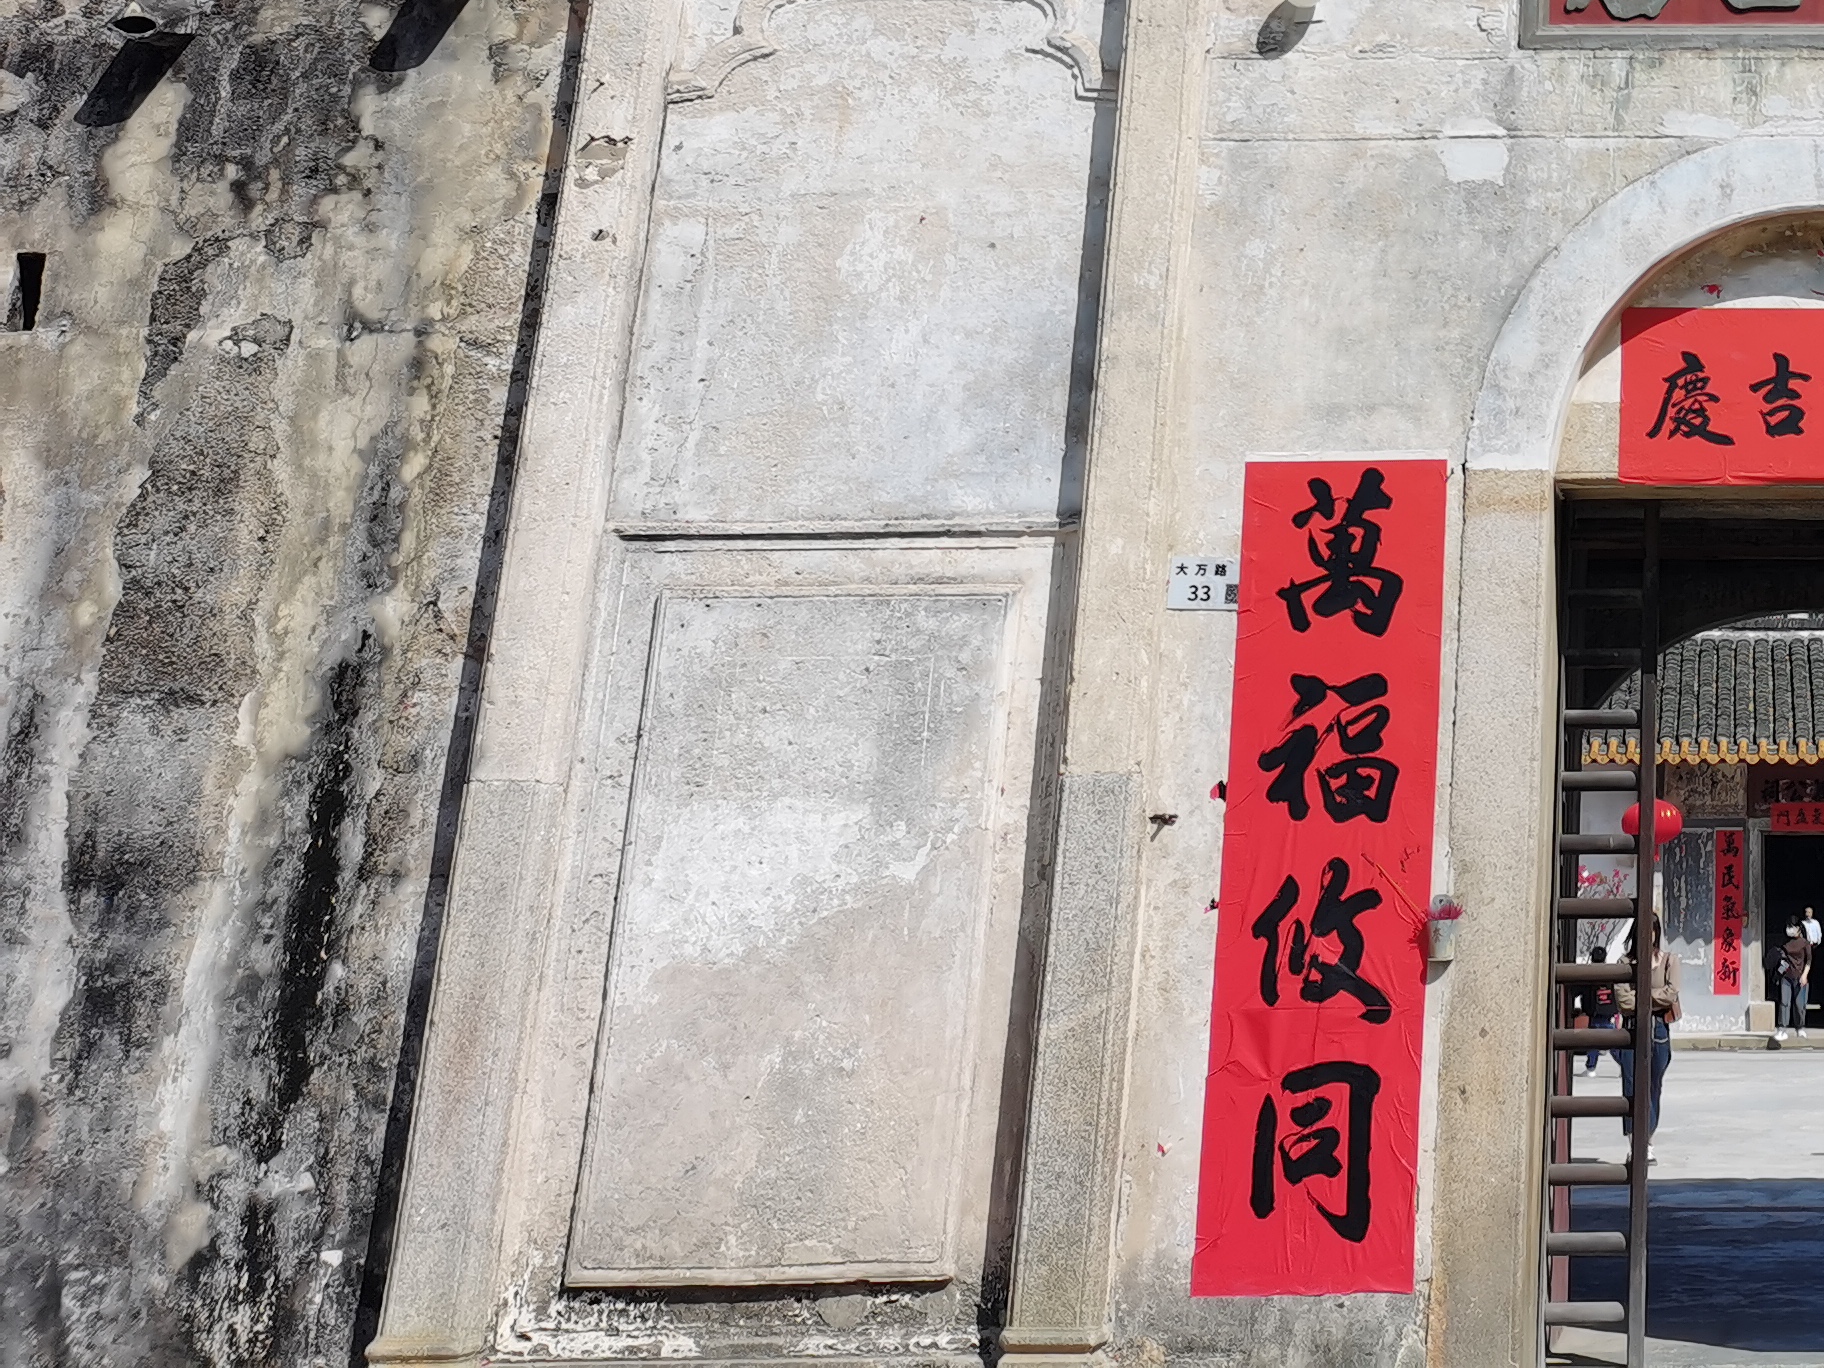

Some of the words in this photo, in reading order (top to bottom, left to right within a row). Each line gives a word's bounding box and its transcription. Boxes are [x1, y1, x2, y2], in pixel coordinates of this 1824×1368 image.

[1175, 562, 1227, 577] 大万路
[1187, 584, 1211, 602] 33
